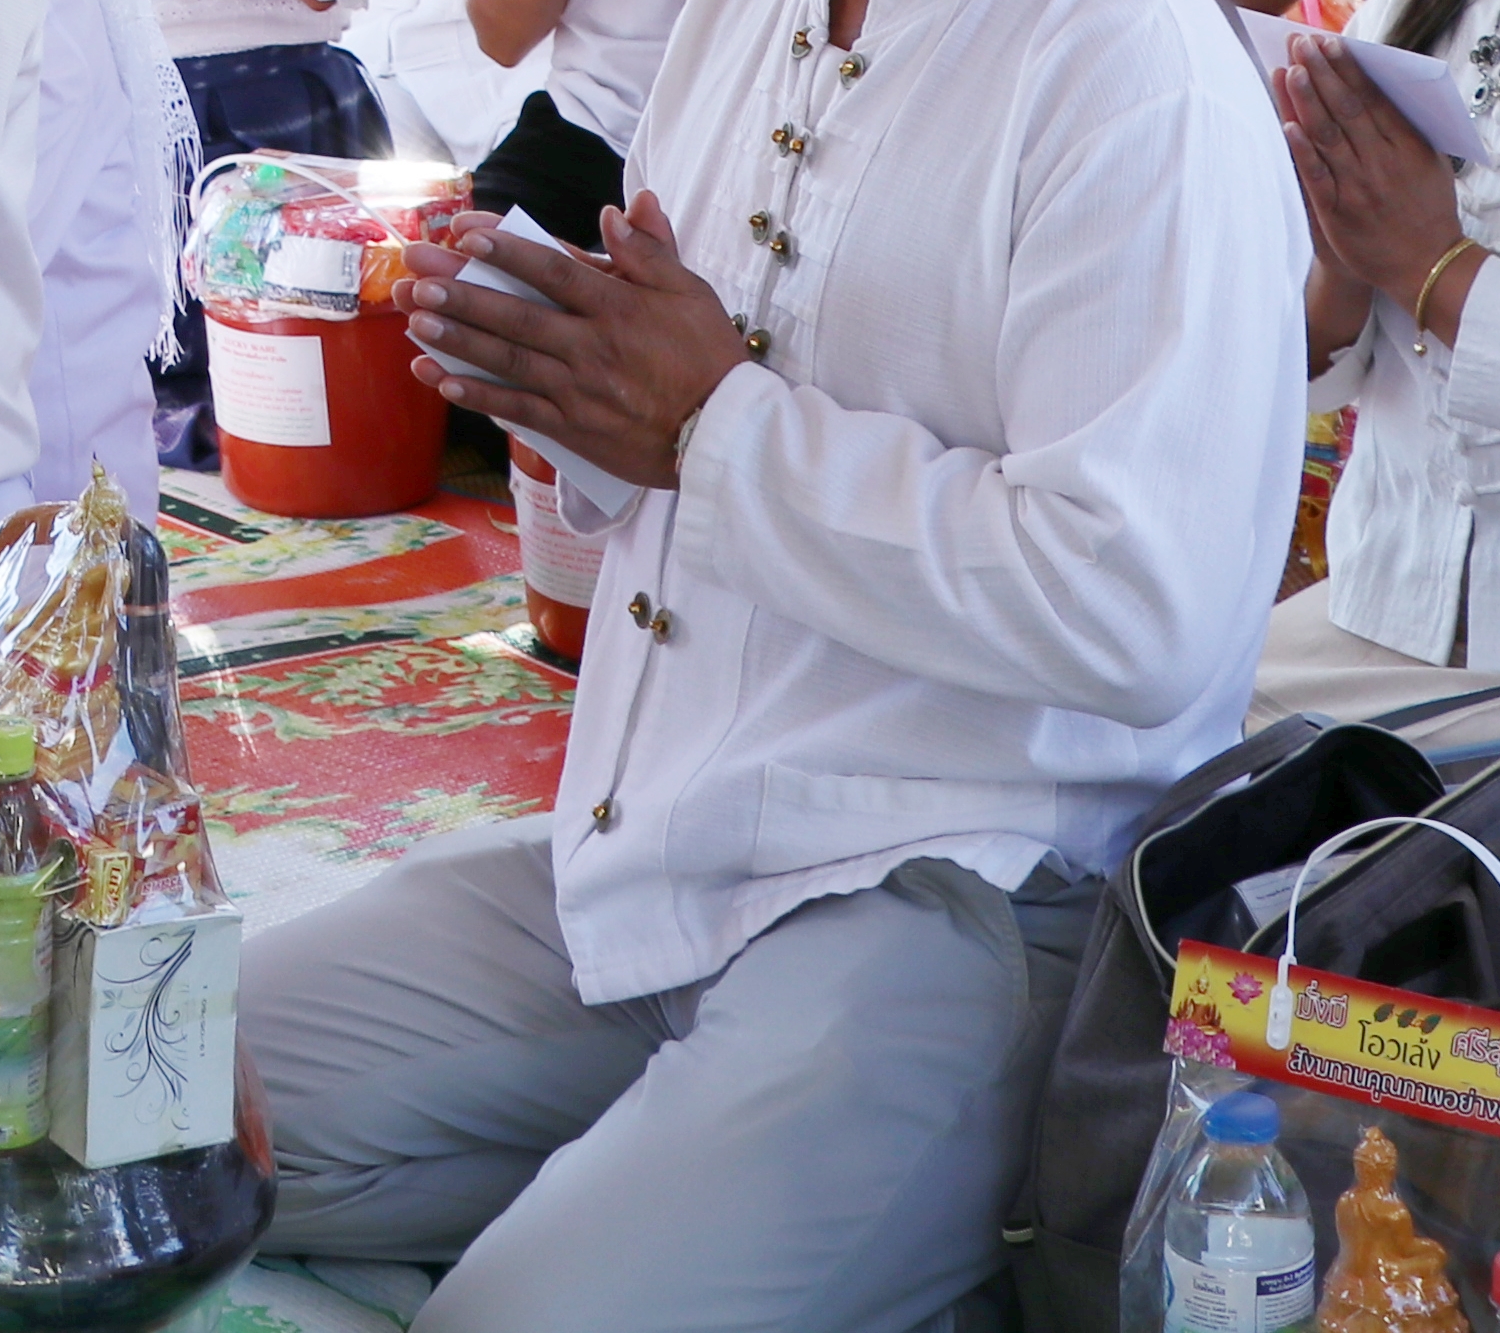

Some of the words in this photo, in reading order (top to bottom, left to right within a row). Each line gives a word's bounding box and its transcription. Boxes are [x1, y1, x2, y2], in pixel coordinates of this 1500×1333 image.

[1295, 979, 1349, 1029] มั่งมี
[1357, 1018, 1441, 1071] โอวเล้ง
